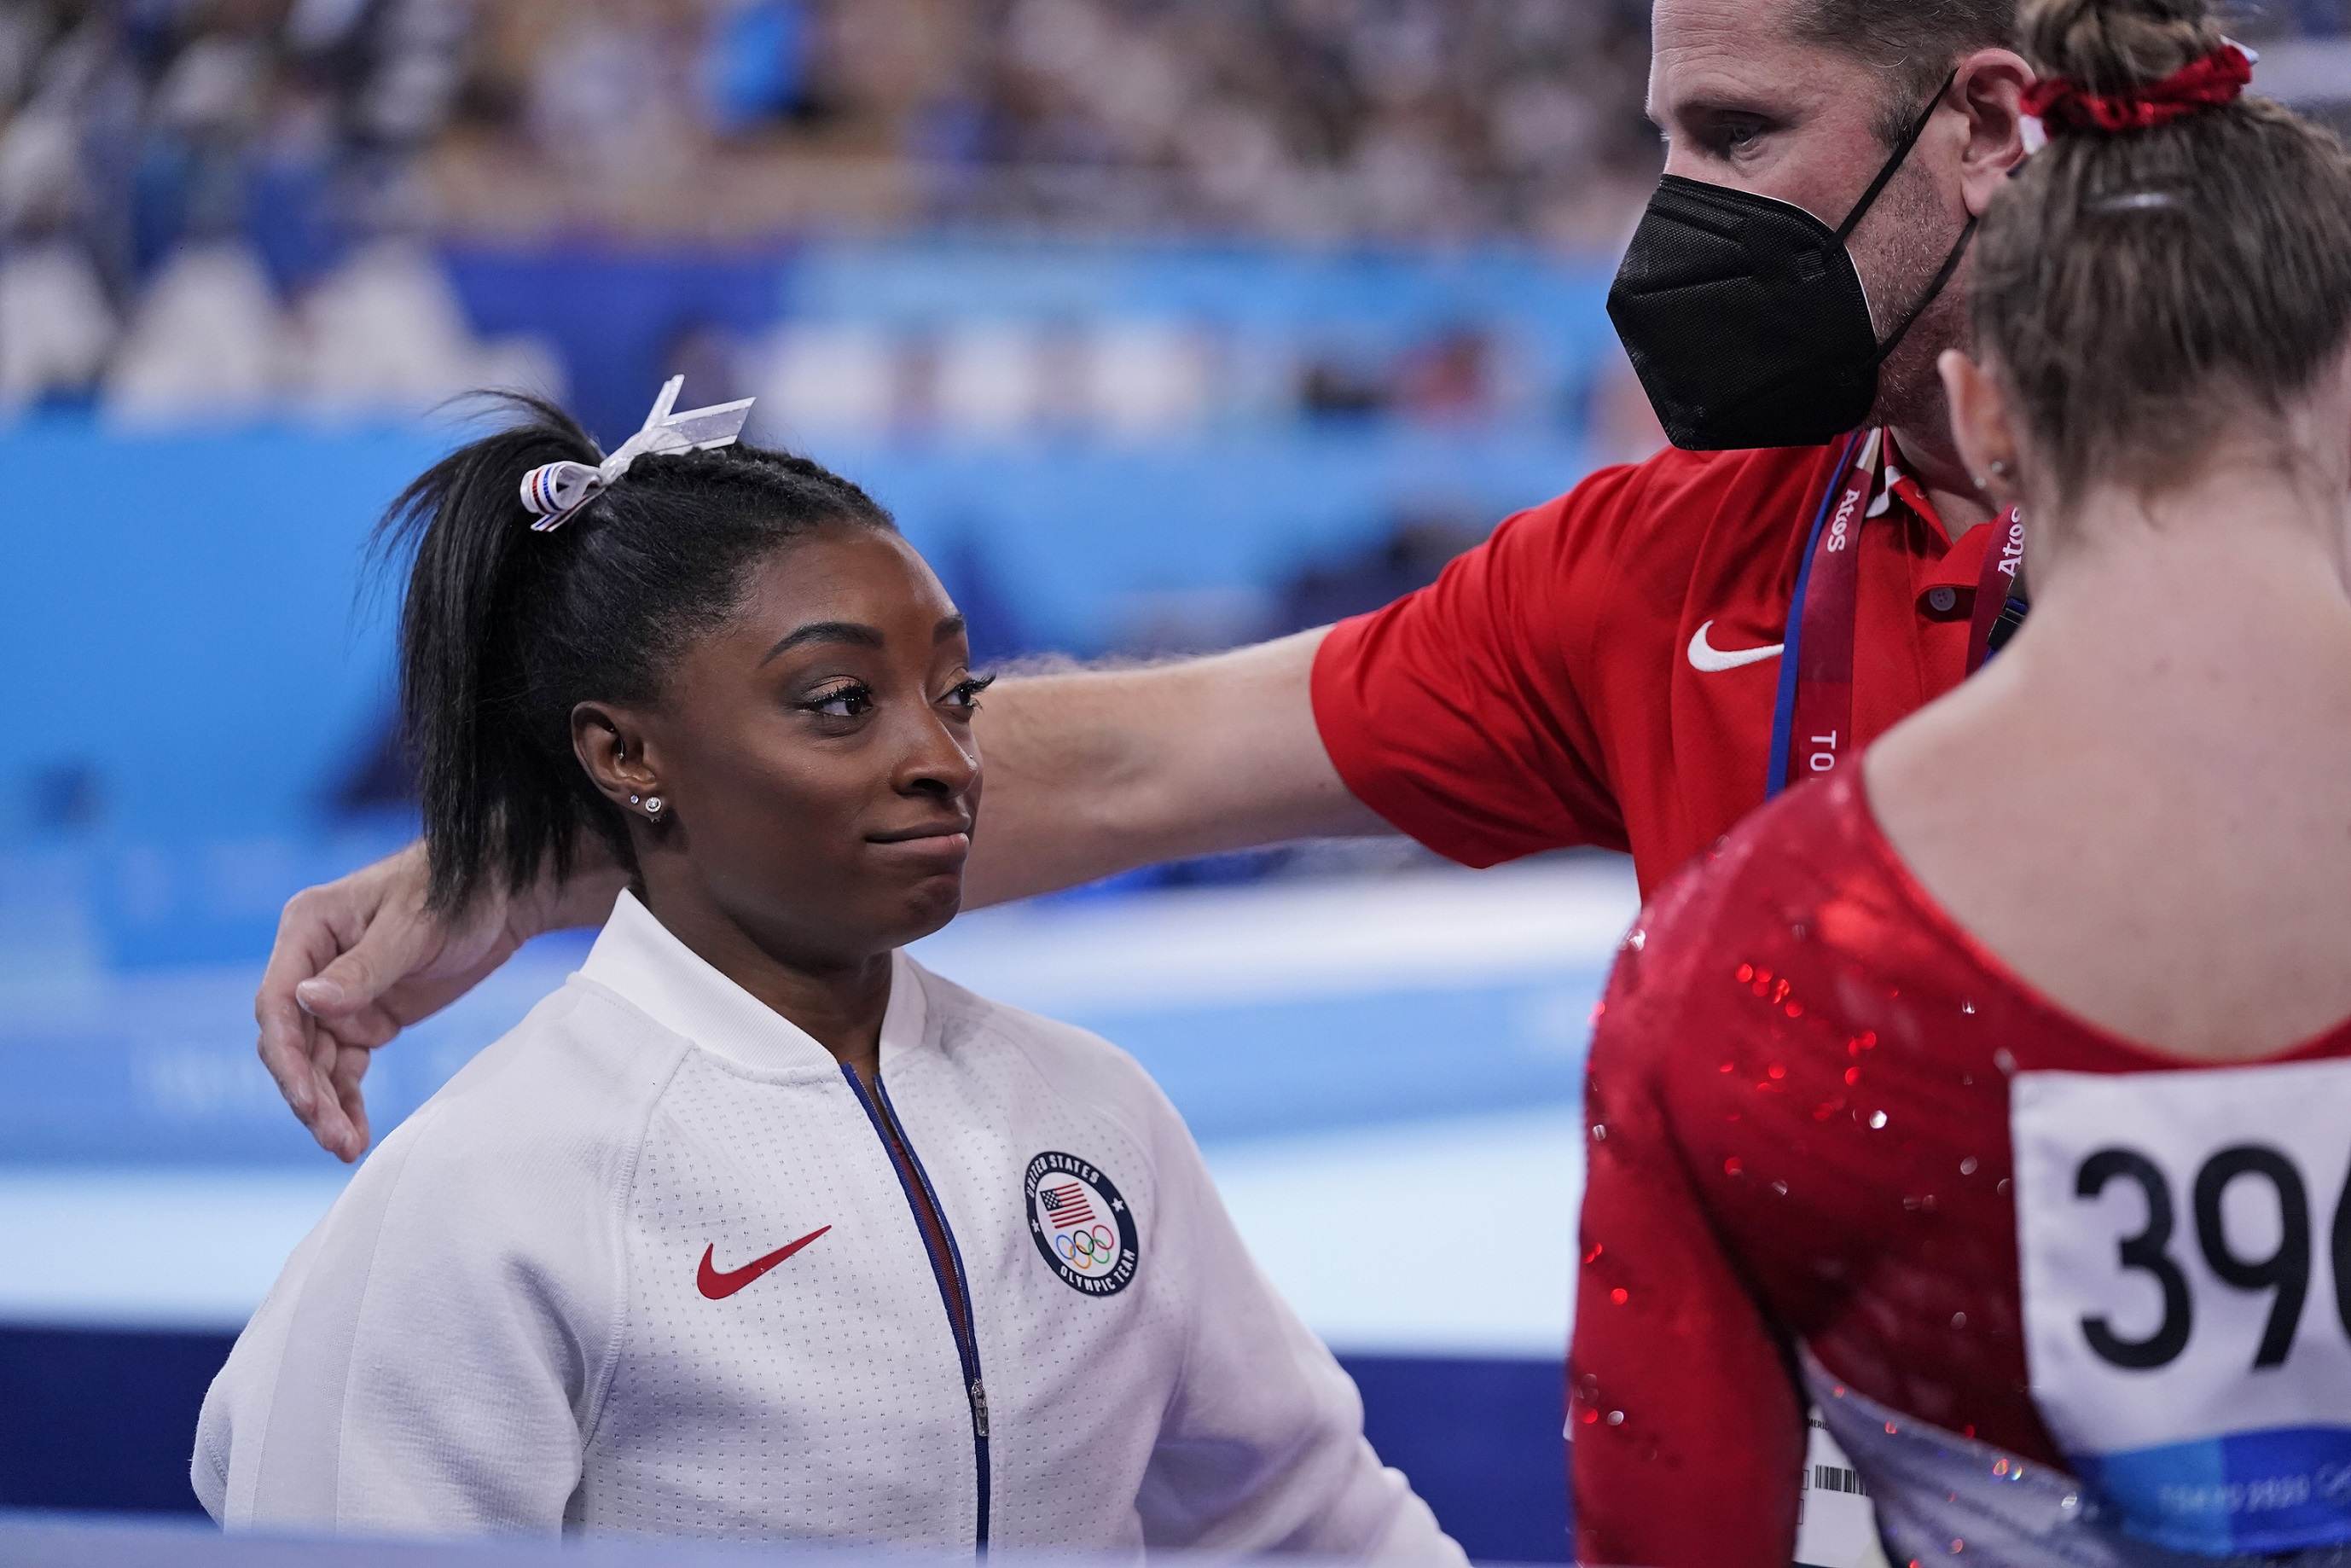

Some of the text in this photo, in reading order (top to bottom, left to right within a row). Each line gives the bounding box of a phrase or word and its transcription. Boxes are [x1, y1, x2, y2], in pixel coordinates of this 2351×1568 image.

[1826, 489, 1861, 553] Atos
[1809, 729, 1837, 781] TO
[1026, 1154, 1100, 1199] UNITED STATES
[1059, 1248, 1136, 1292] OLYMPIC TEAM
[2075, 1146, 2351, 1372] 39
